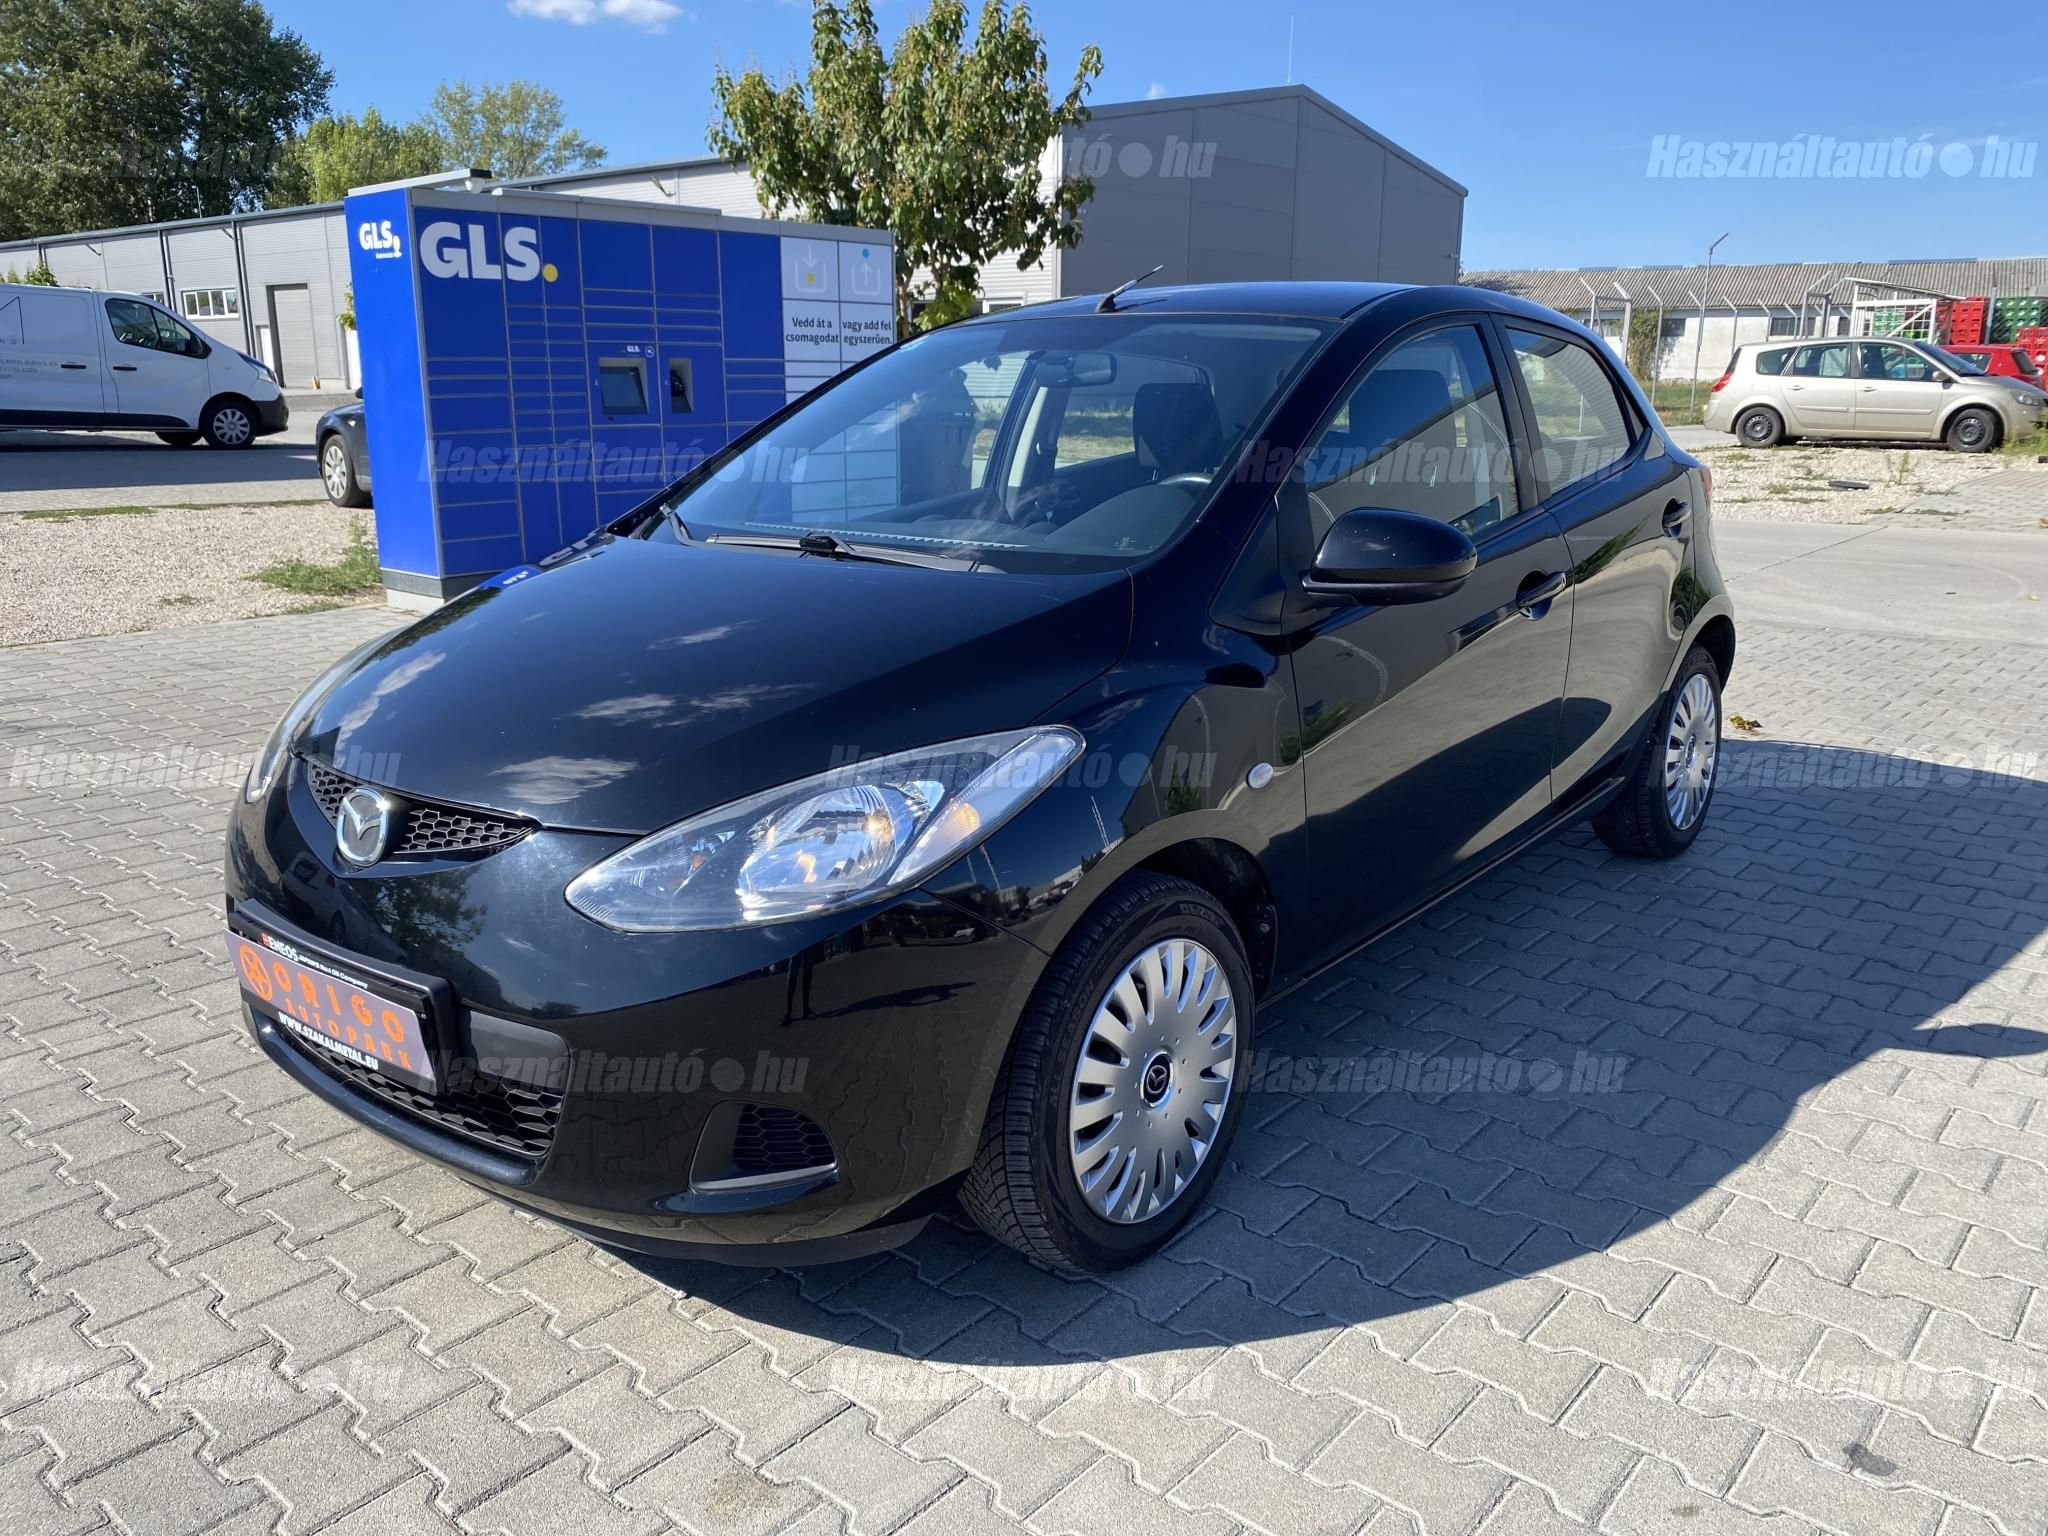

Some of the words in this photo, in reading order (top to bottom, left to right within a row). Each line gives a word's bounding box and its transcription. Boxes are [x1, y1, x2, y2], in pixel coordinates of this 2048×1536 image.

[785, 332, 839, 345] csomagodat
[792, 317, 814, 328] Vedd
[816, 317, 825, 329] át
[827, 320, 832, 329] a
[842, 321, 862, 332] vagy
[863, 320, 879, 330] add
[880, 320, 891, 330] fel
[267, 935, 299, 962] ENEOS
[340, 972, 368, 989] Company
[272, 962, 404, 1043] ORIGO
[278, 1011, 379, 1070] WWW.SZAKALMETAL.EU
[284, 997, 413, 1070] AUTOPARK
